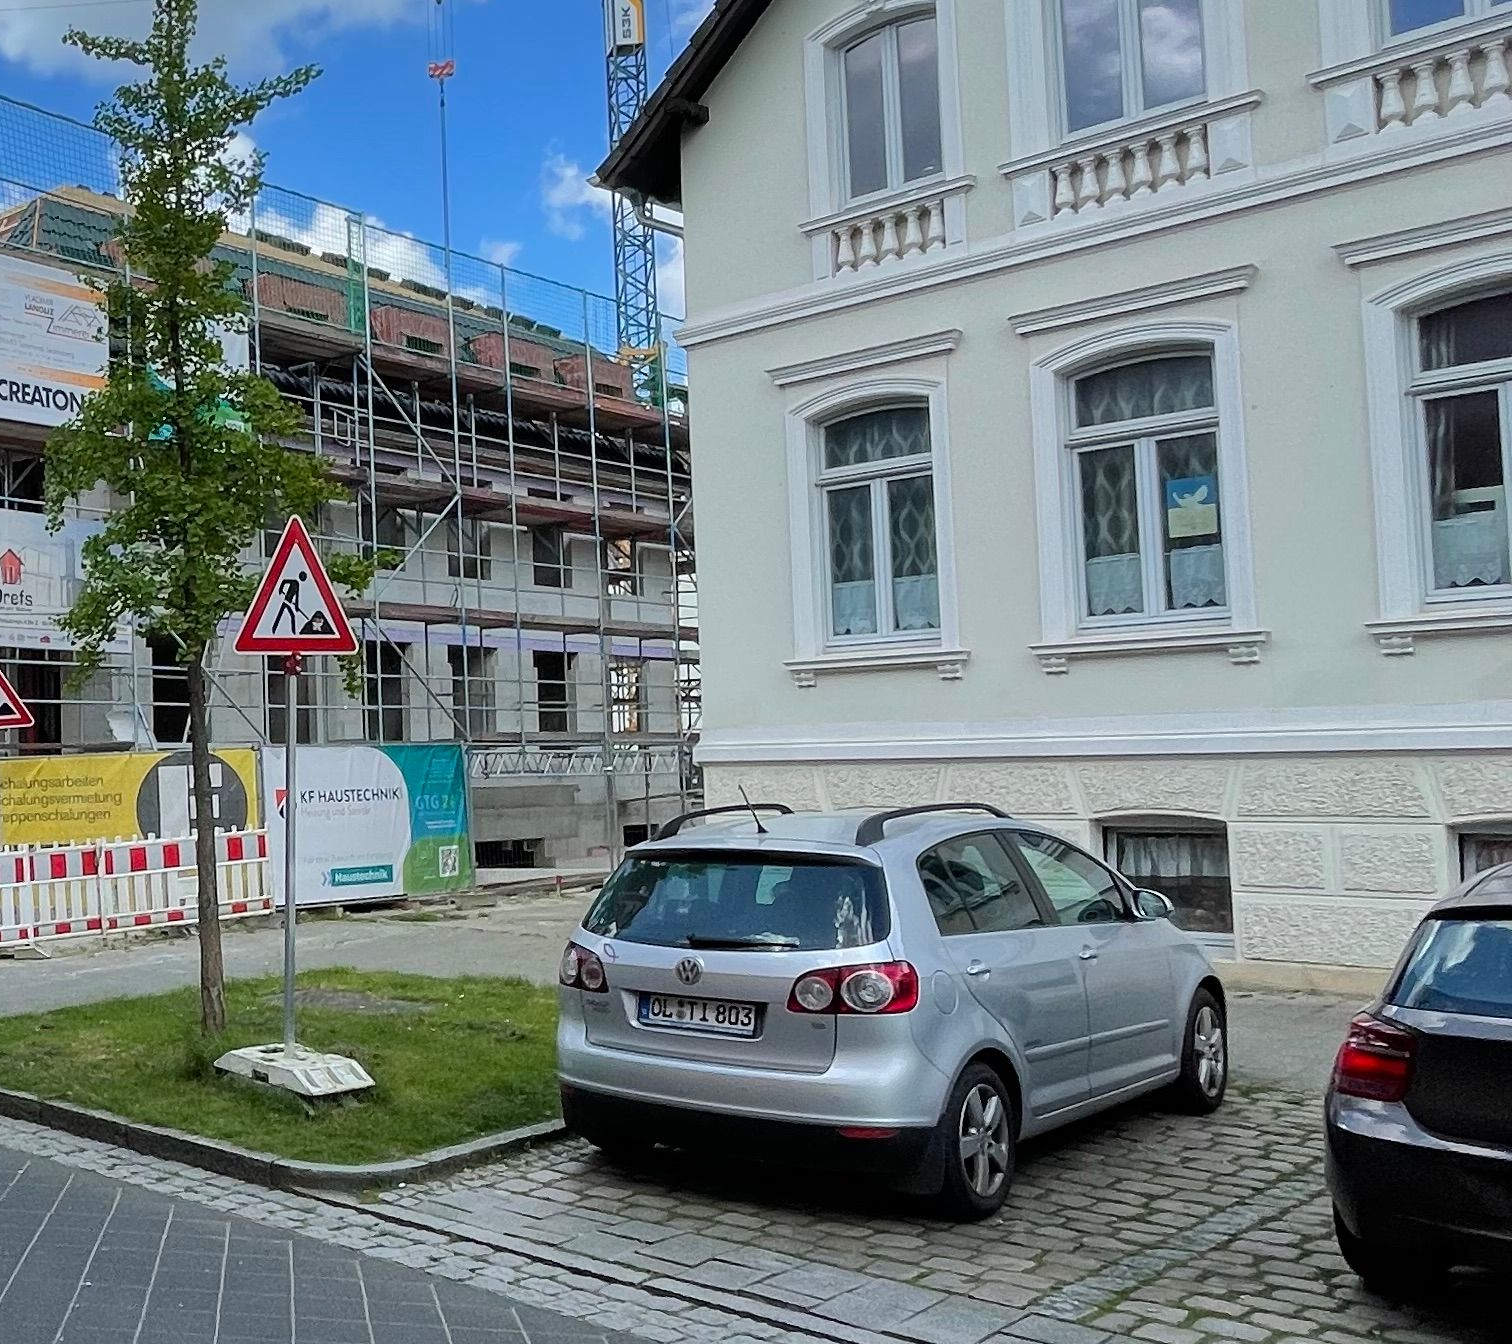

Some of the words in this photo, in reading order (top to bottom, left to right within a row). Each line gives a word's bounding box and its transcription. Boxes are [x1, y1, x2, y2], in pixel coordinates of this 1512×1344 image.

[300, 790, 314, 804] KF
[317, 787, 400, 803] HAUSTECHNIK
[334, 868, 389, 883] Haustechnik
[651, 997, 673, 1019] OL
[688, 1003, 709, 1023] TI
[715, 1005, 753, 1027] 803
